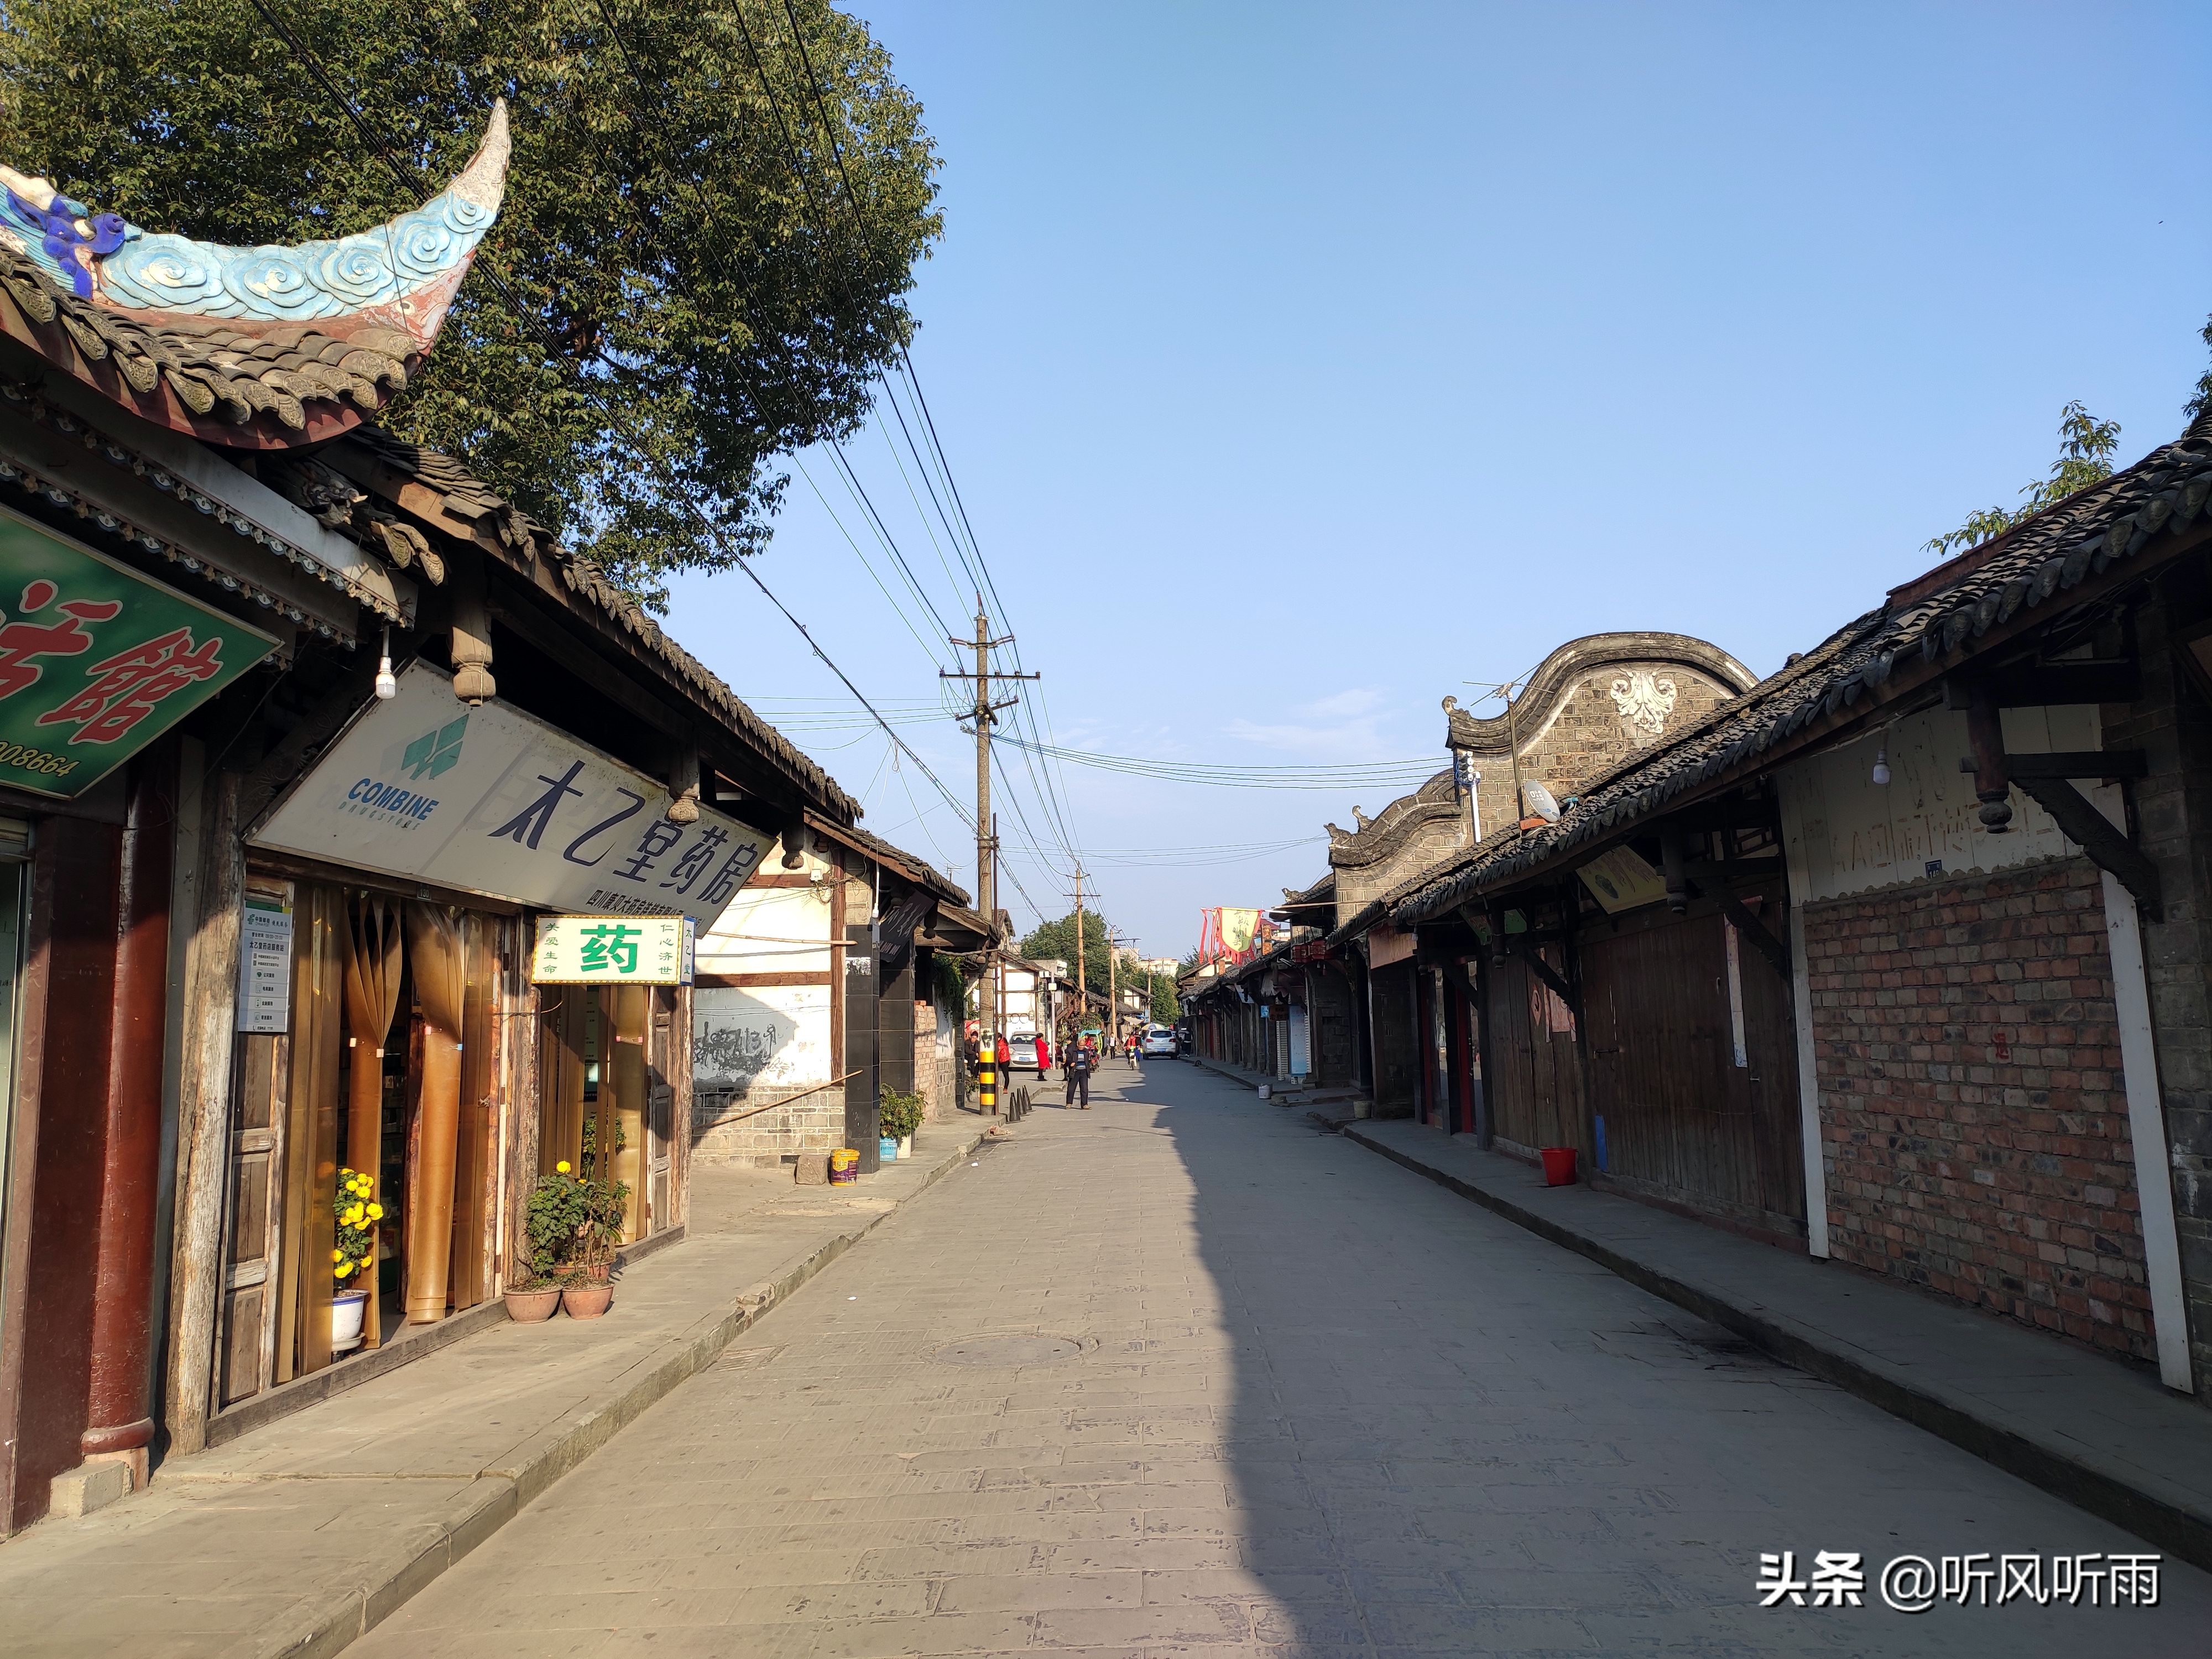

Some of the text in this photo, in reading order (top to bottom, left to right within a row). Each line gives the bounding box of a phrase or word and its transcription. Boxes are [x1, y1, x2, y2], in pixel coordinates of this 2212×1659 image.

[348, 778, 440, 820] COMBINE
[488, 760, 759, 905] 太乙堂药房
[543, 922, 560, 974] 关爱生命
[580, 924, 642, 973] 药
[658, 924, 675, 975] 仁心济世
[684, 927, 692, 975] 太乙堂
